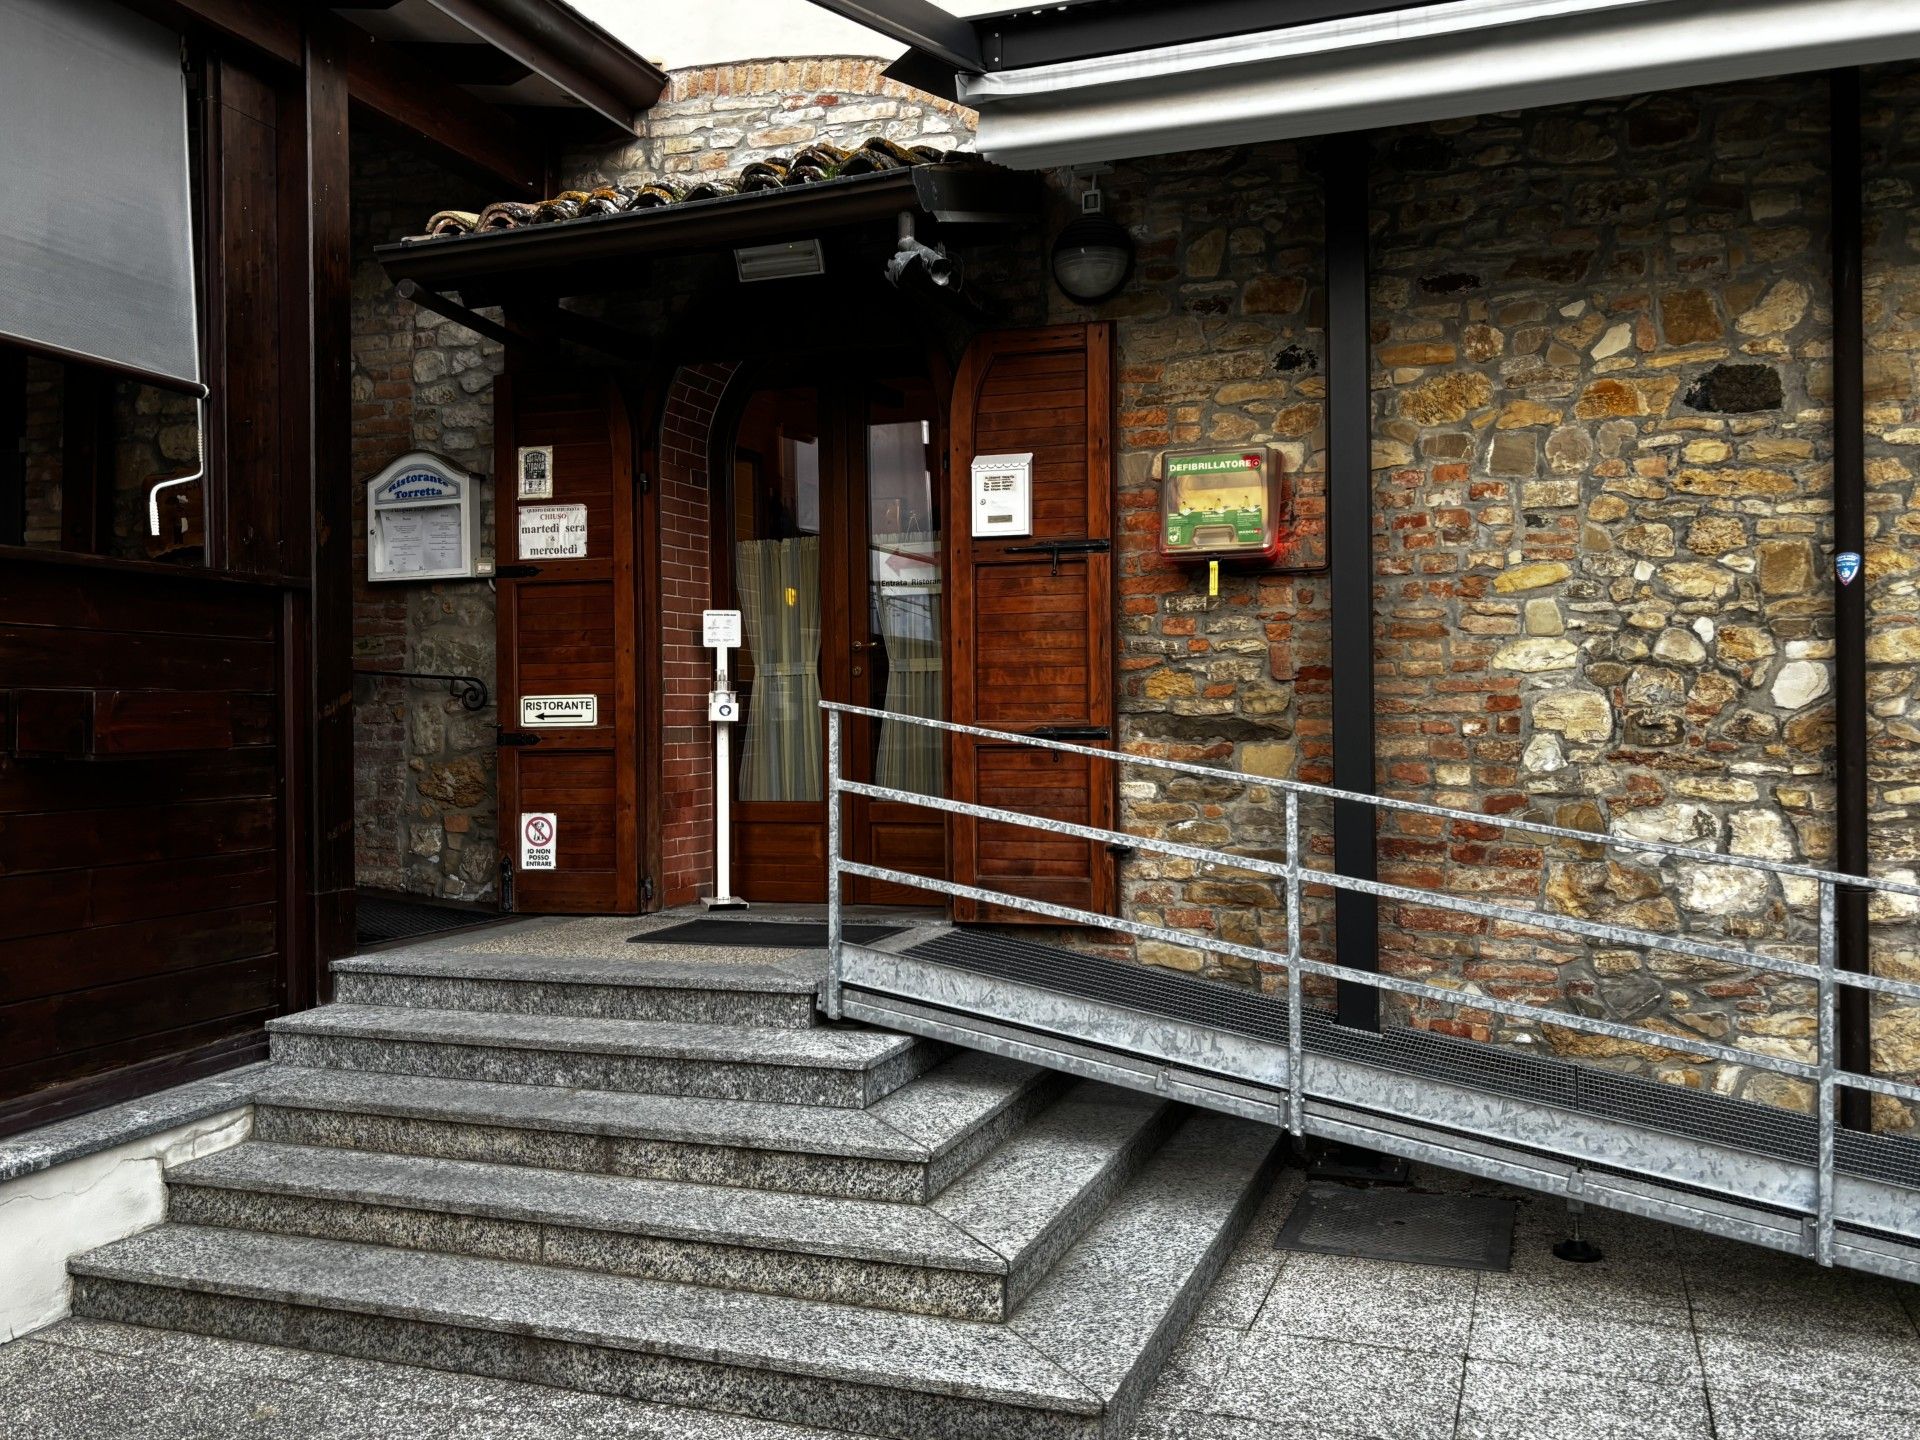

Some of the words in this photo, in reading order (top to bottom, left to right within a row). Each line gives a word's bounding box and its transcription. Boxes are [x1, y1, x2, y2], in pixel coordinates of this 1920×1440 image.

[1169, 460, 1251, 472] DEFIBRILLATORE
[388, 473, 449, 493] Ristorante
[394, 487, 442, 498] Torretta
[539, 513, 567, 521] CHIUSO
[565, 523, 585, 533] sera
[525, 700, 592, 711] RISTORANTE
